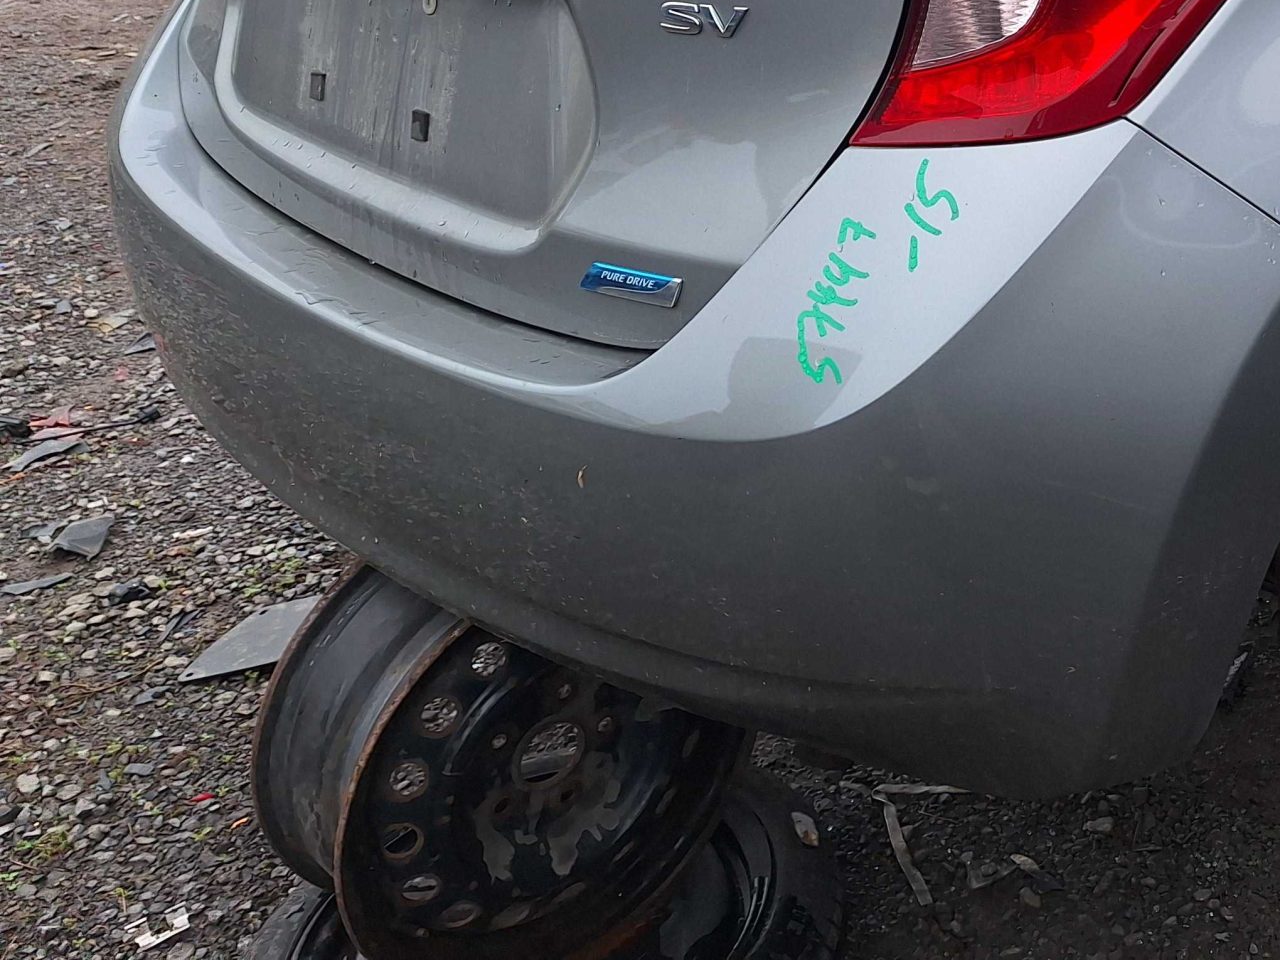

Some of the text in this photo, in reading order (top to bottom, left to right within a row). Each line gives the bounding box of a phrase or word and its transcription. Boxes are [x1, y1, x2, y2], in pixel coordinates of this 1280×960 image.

[660, 1, 750, 38] SV
[601, 270, 655, 289] PURE DRIVE
